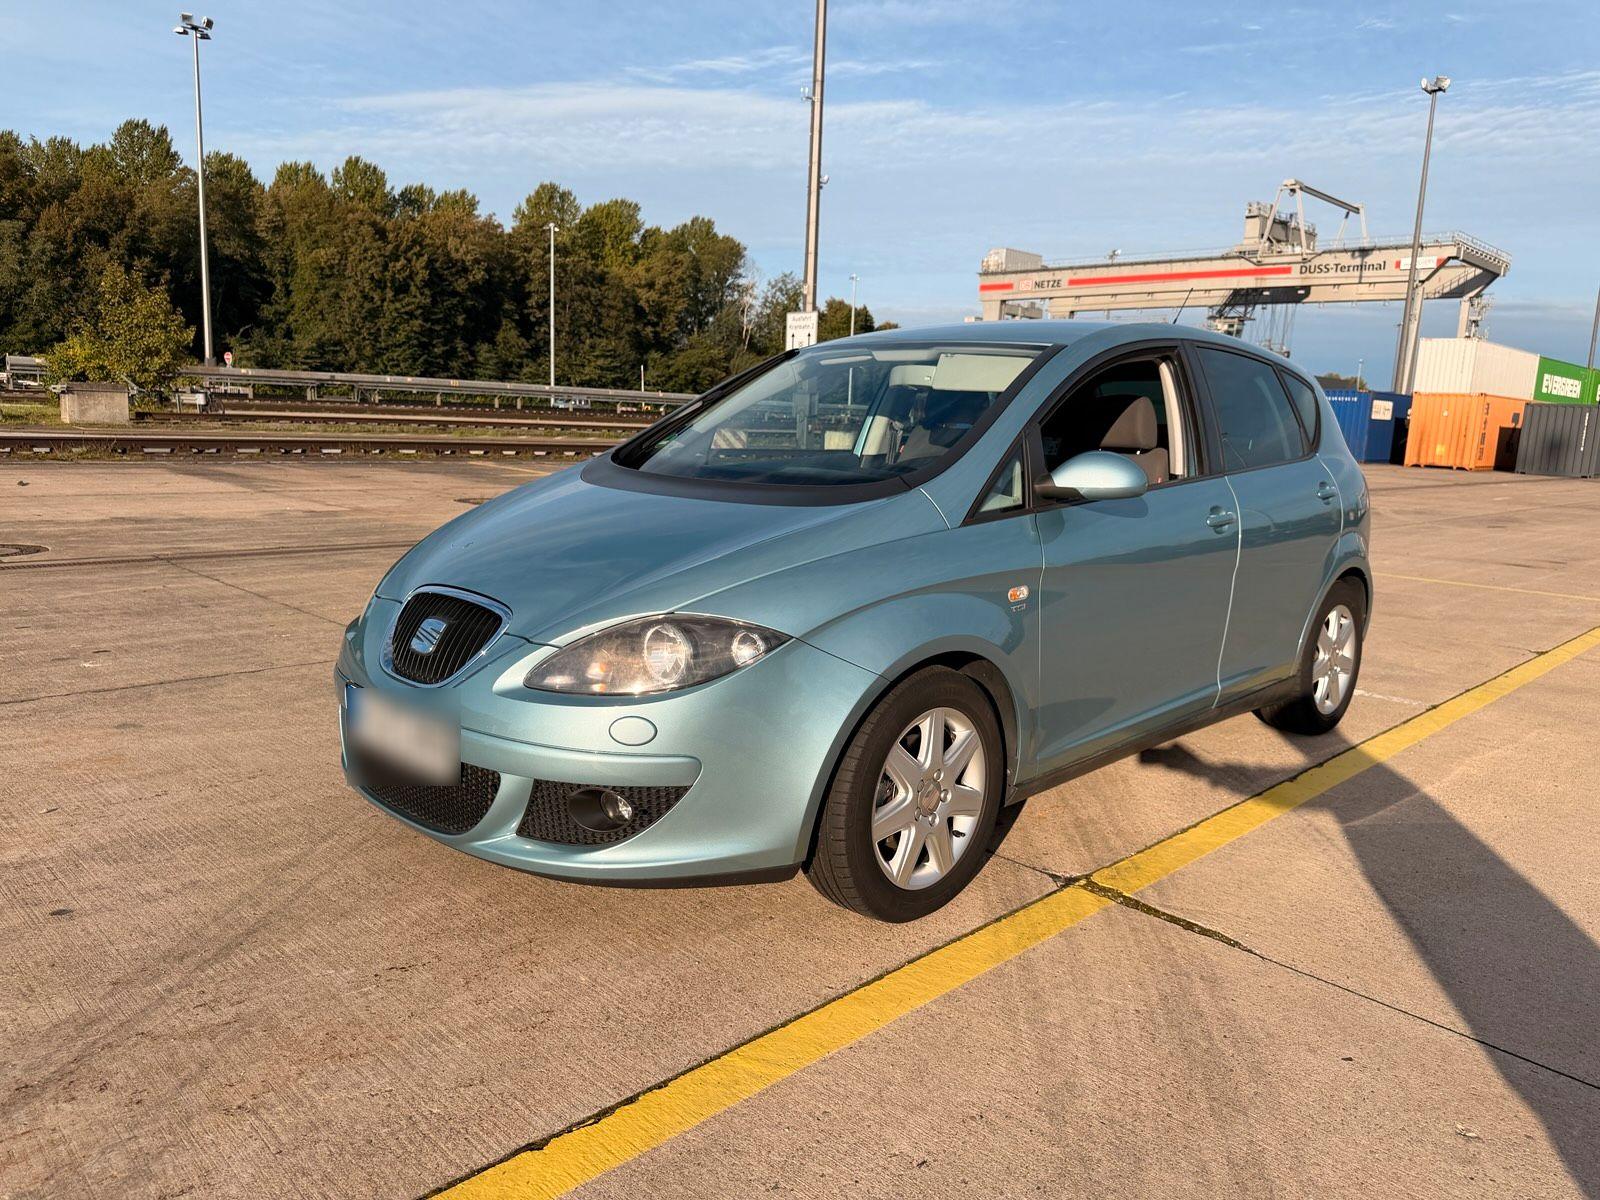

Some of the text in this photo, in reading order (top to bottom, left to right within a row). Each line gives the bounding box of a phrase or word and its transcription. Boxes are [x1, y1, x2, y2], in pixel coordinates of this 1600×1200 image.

[1299, 260, 1386, 275] DUSS-Terminal
[1034, 279, 1062, 289] NETZE
[1541, 373, 1582, 399] EVERGREEN
